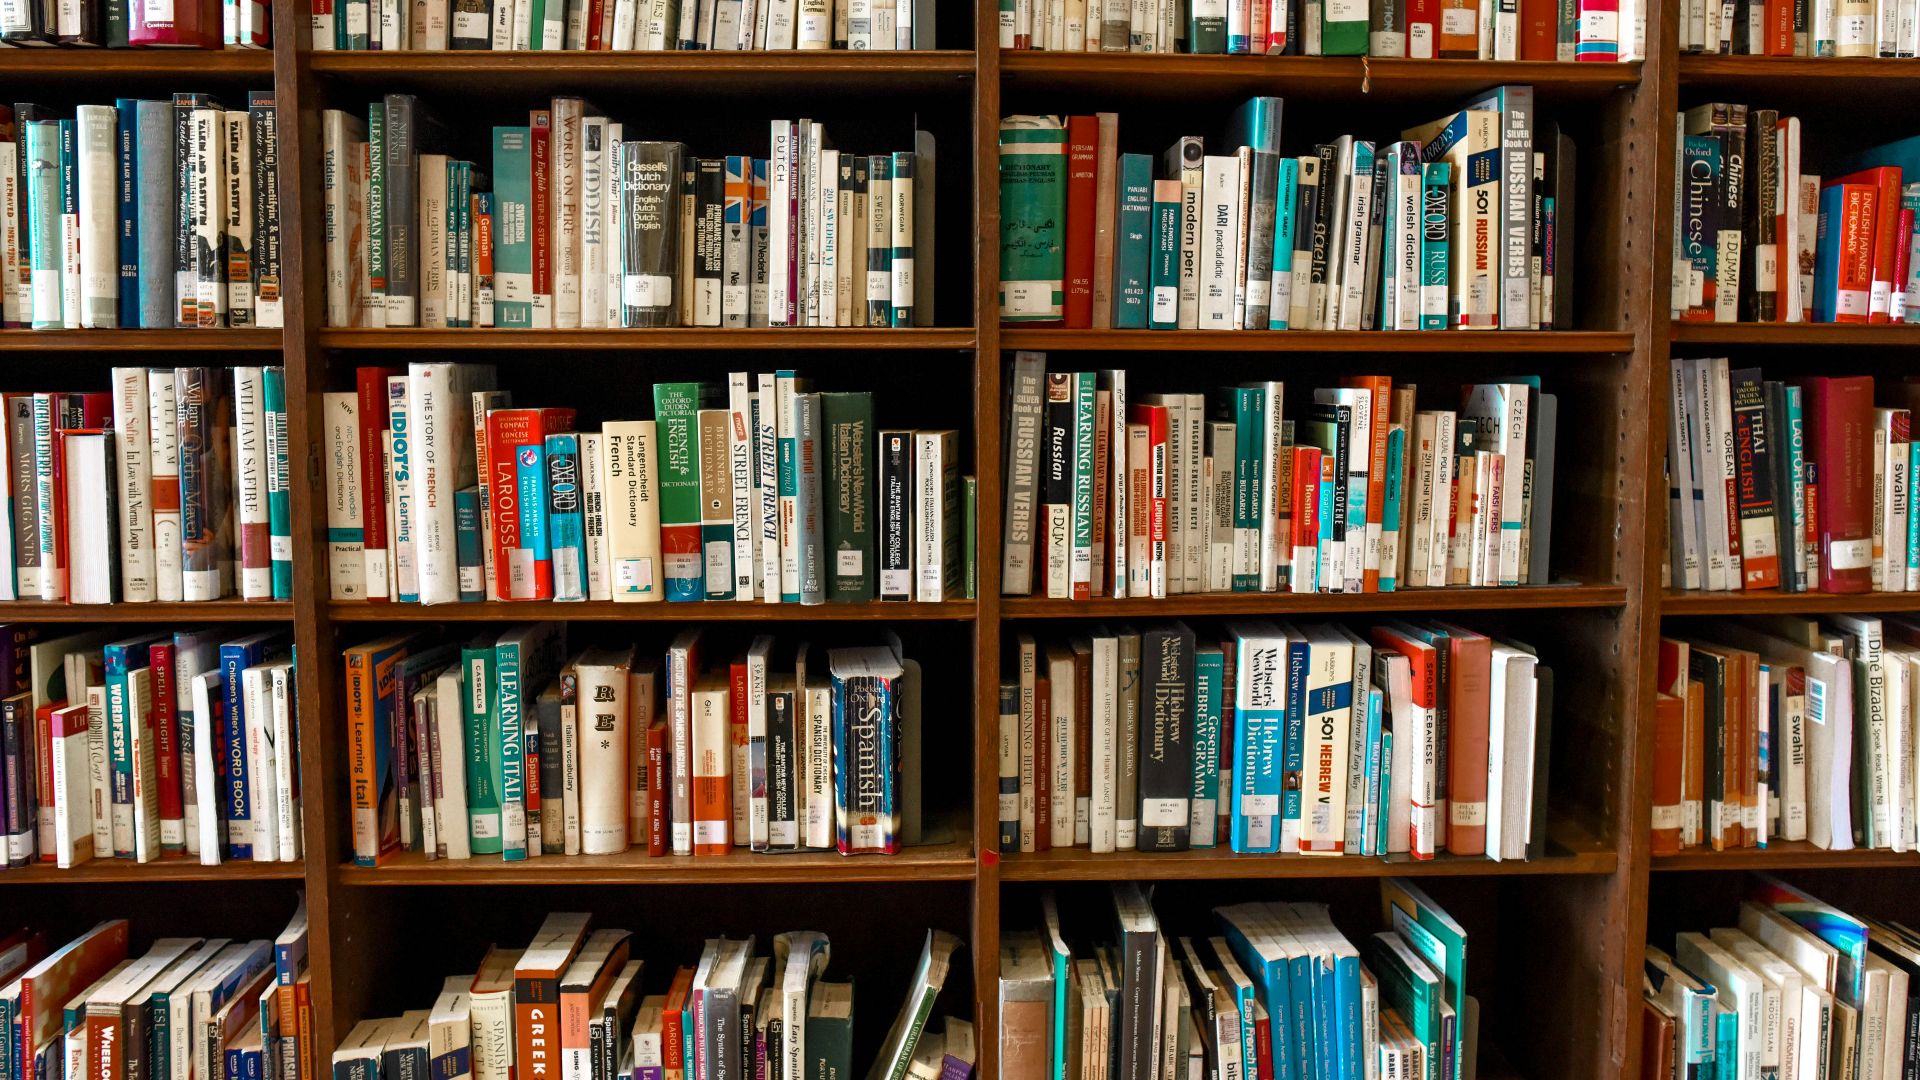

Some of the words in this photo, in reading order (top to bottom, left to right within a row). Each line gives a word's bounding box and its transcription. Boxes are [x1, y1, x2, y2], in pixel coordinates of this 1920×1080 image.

[256, 121, 266, 147] Reader
[371, 123, 381, 182] LEARNING
[563, 116, 577, 169] WORDS
[257, 149, 265, 158] in
[777, 135, 785, 182] DUTCH
[65, 184, 71, 196] we
[256, 160, 267, 189] African
[564, 175, 575, 196] ON
[1509, 152, 1526, 220] RUSSIAN
[1727, 154, 1742, 208] Chinese
[6, 177, 14, 217] DEPRAVED
[257, 192, 268, 228] American
[372, 185, 381, 237] GERMAN
[875, 195, 883, 232] SWEDISH
[1357, 196, 1366, 217] irish
[1406, 195, 1415, 229] welsh
[1424, 190, 1447, 240] OXFORD
[1477, 190, 1488, 214] 501
[1688, 159, 1712, 254] Chinese
[431, 217, 439, 256] GERMAN
[516, 204, 525, 242] SWEDISH
[564, 203, 576, 235] FIRE
[698, 217, 706, 256] DICTIONARY
[1185, 192, 1198, 245] modern
[1847, 192, 1858, 253] DICTIONARY
[258, 230, 269, 265] Expressive
[372, 239, 381, 272] BOOK
[481, 218, 490, 257] German
[1352, 221, 1363, 265] grammar
[1476, 219, 1488, 269] RUSSIAN
[1508, 227, 1525, 276] VERBS
[431, 260, 439, 291] VERBS
[564, 247, 573, 271] Dovid
[124, 376, 138, 413] William
[424, 392, 432, 412] THE
[126, 417, 139, 446] Safire
[239, 379, 254, 451] WILLIAM
[425, 415, 434, 448] STORY
[735, 417, 744, 437] more
[1079, 393, 1092, 470] LEARNING
[1513, 400, 1522, 439] CZECH
[1739, 415, 1747, 424] &
[1792, 419, 1802, 447] LAO
[392, 412, 409, 481] IDIOT'S
[476, 429, 485, 445] 1001
[678, 419, 688, 464] FRENCH
[1014, 416, 1035, 485] RUSSIAN
[1052, 426, 1065, 480] Russian
[1441, 416, 1450, 455] COLLOQUIAL
[126, 451, 140, 459] In
[127, 462, 141, 479] Love
[334, 441, 344, 469] English
[345, 446, 355, 483] Compact
[426, 450, 434, 464] OF
[477, 445, 487, 475] PITFALLS
[680, 466, 689, 475] &
[733, 445, 748, 492] STREET
[1171, 419, 1179, 502] BULGARIAN-ENGLISH
[1190, 420, 1198, 502] BULGARIAN-ENGLISH
[1439, 456, 1448, 483] POLISH
[1739, 428, 1753, 499] ENGLISH
[1793, 450, 1802, 477] FOR
[128, 482, 141, 498] with
[243, 458, 257, 513] SAFIRE
[335, 472, 345, 511] Dictionary
[427, 467, 436, 508] FRENCH
[479, 475, 488, 483] IN
[481, 485, 490, 510] FRENCH
[551, 460, 577, 510] OXFORD
[1492, 486, 1500, 507] FARSI
[1894, 463, 1905, 515] swahili
[128, 501, 142, 526] Norma
[349, 486, 357, 520] Swedish
[398, 495, 411, 542] Learning
[1012, 491, 1031, 541] VERBS
[1077, 474, 1090, 538] RUSSIAN
[1303, 484, 1315, 525] Bosnian
[1322, 489, 1330, 520] Croatian
[1807, 488, 1816, 532] Mandarin
[228, 661, 238, 703] Children's
[475, 665, 483, 709] CASSELL'S
[1290, 651, 1303, 691] Hebrew
[1355, 663, 1367, 707] Prayerbook
[500, 671, 518, 755] LEARNING
[736, 675, 744, 721] LAROUSSE
[1126, 699, 1134, 731] HEBREW
[1291, 706, 1299, 718] THE
[230, 706, 239, 735] Writer's
[813, 714, 822, 747] SPANISH
[1126, 733, 1134, 741] IN
[1290, 719, 1301, 740] Rest
[1355, 708, 1366, 738] Hebrew
[1900, 705, 1909, 754] Navajo-English
[231, 738, 242, 776] WORD
[851, 707, 883, 806] Spanish
[1289, 743, 1296, 751] OF
[1355, 740, 1364, 752] the
[1372, 741, 1380, 763] IRAQI
[1792, 715, 1804, 765] swahili
[529, 757, 538, 794] Spanish
[566, 750, 574, 791] vocabulary
[737, 754, 745, 791] SPANISH
[813, 749, 823, 795] DICTIONARY
[1126, 743, 1134, 777] AMERICA
[1288, 754, 1300, 767] Us
[1353, 754, 1362, 771] Easy
[1899, 756, 1908, 789] Dictionary
[233, 781, 244, 816] BOOK
[1351, 773, 1361, 789] Way
[281, 972, 290, 984] THE
[154, 1008, 166, 1030] ESL
[281, 989, 293, 1031] ULTIMATE
[1701, 1000, 1709, 1048] DICTIONARY
[1767, 997, 1775, 1052] INDONESIAN
[530, 1009, 545, 1075] GREEK
[605, 1016, 613, 1047] Spanish
[716, 1033, 725, 1058] Syntax
[1867, 1017, 1875, 1056] REFERENCE
